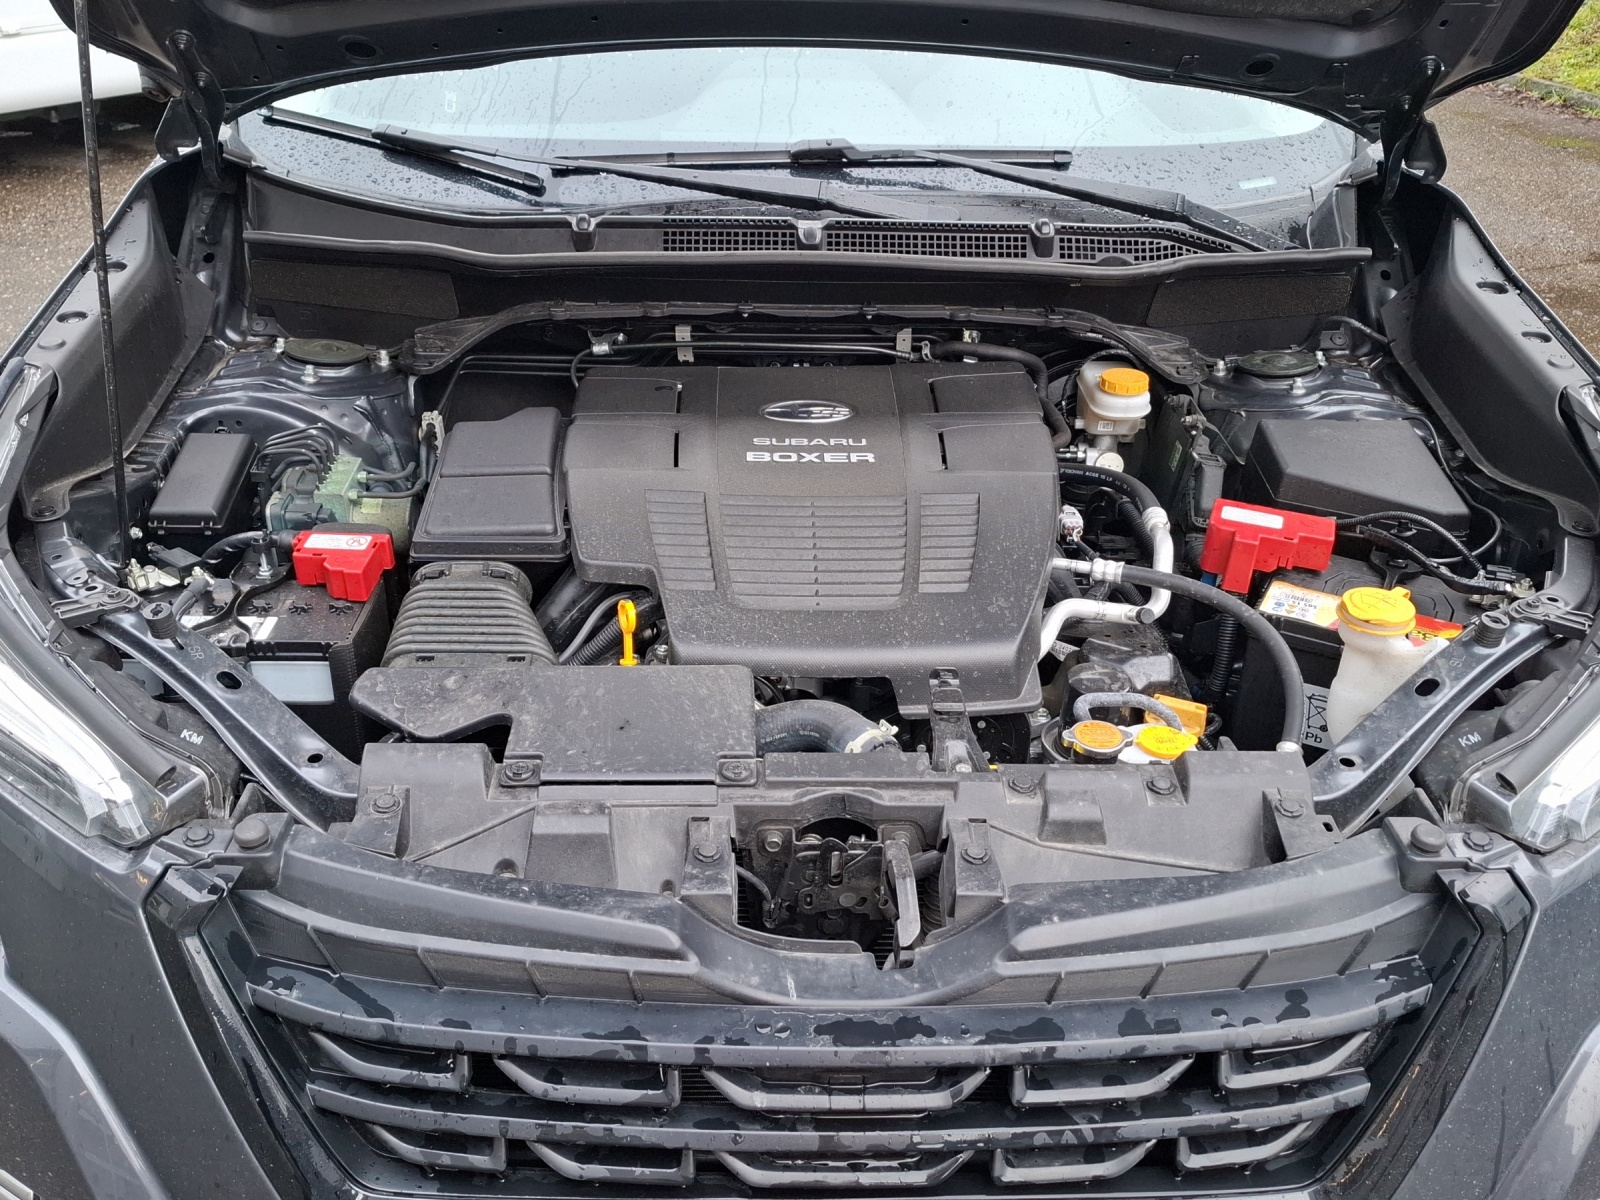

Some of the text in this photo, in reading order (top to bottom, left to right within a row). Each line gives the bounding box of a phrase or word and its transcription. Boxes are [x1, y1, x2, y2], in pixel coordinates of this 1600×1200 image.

[752, 437, 867, 446] SUBARU
[746, 451, 876, 463] BOXER
[188, 646, 205, 661] SR
[1449, 655, 1467, 668] SL
[179, 728, 204, 745] KM
[1304, 731, 1323, 744] Pb
[1457, 731, 1482, 748] KM
